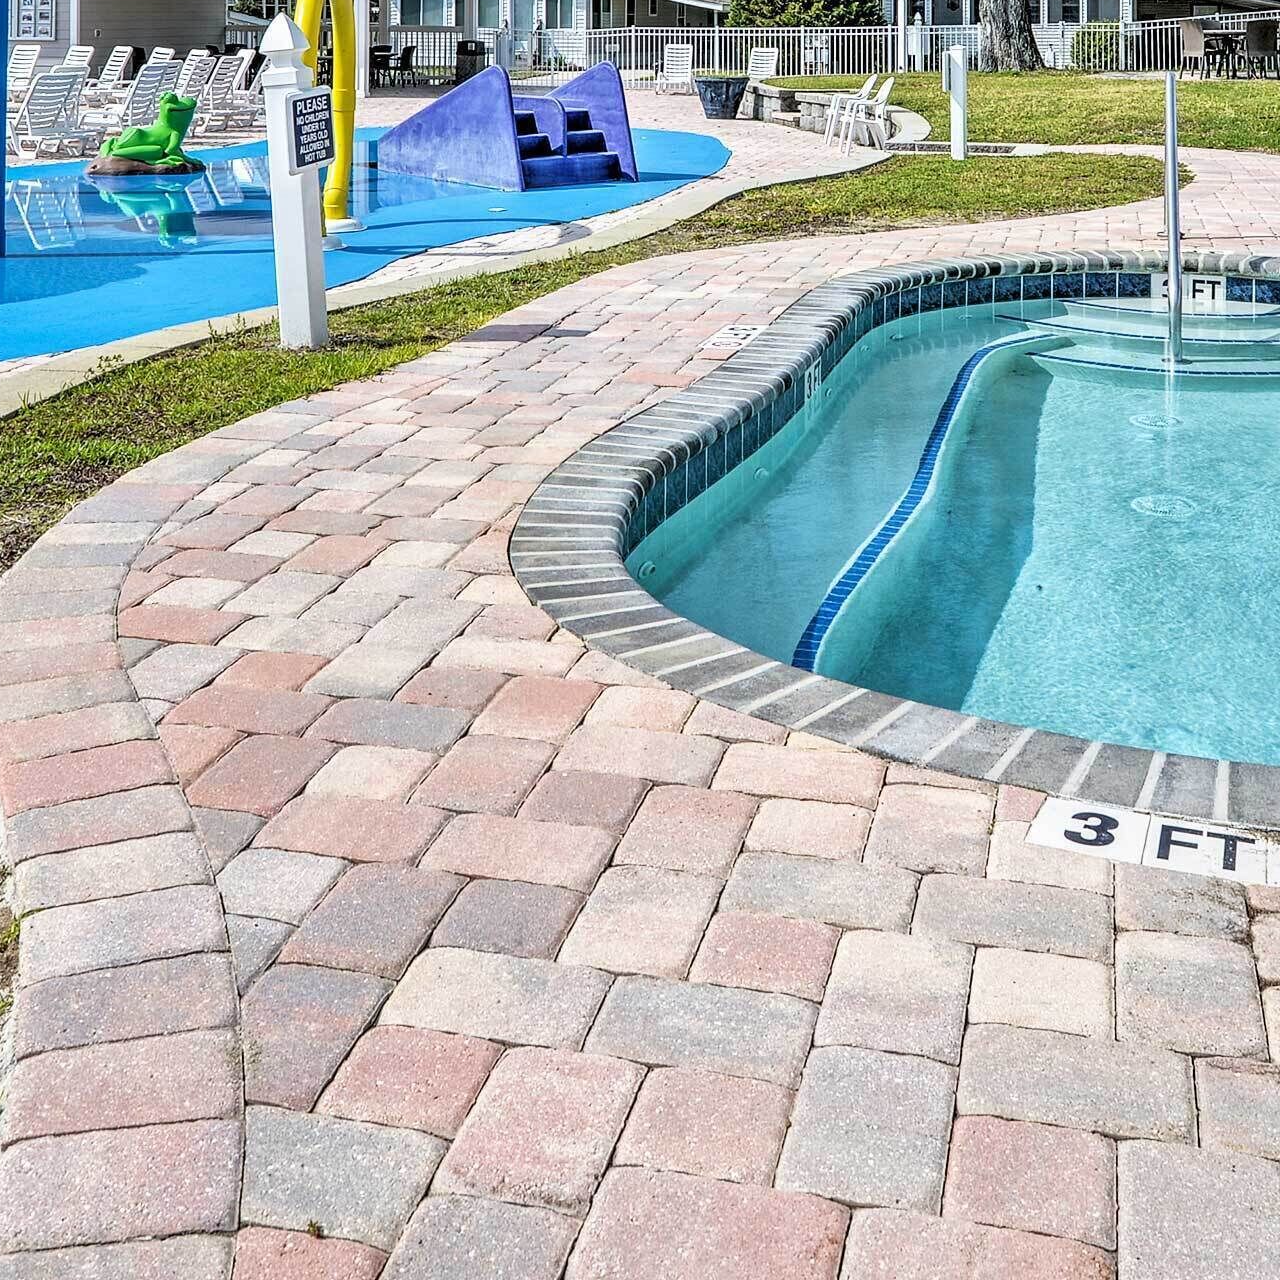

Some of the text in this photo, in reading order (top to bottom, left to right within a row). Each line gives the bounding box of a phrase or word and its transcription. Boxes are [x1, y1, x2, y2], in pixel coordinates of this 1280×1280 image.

[296, 96, 328, 115] PLEASE
[296, 110, 329, 126] NO CHILDREN
[301, 121, 326, 134] UNDER 12
[300, 129, 328, 144] YEARS OLD
[300, 139, 330, 155] ALLOWED IN
[304, 149, 327, 163] HOT TUB
[1192, 279, 1221, 300] FT
[1064, 812, 1256, 871] 3 FT
